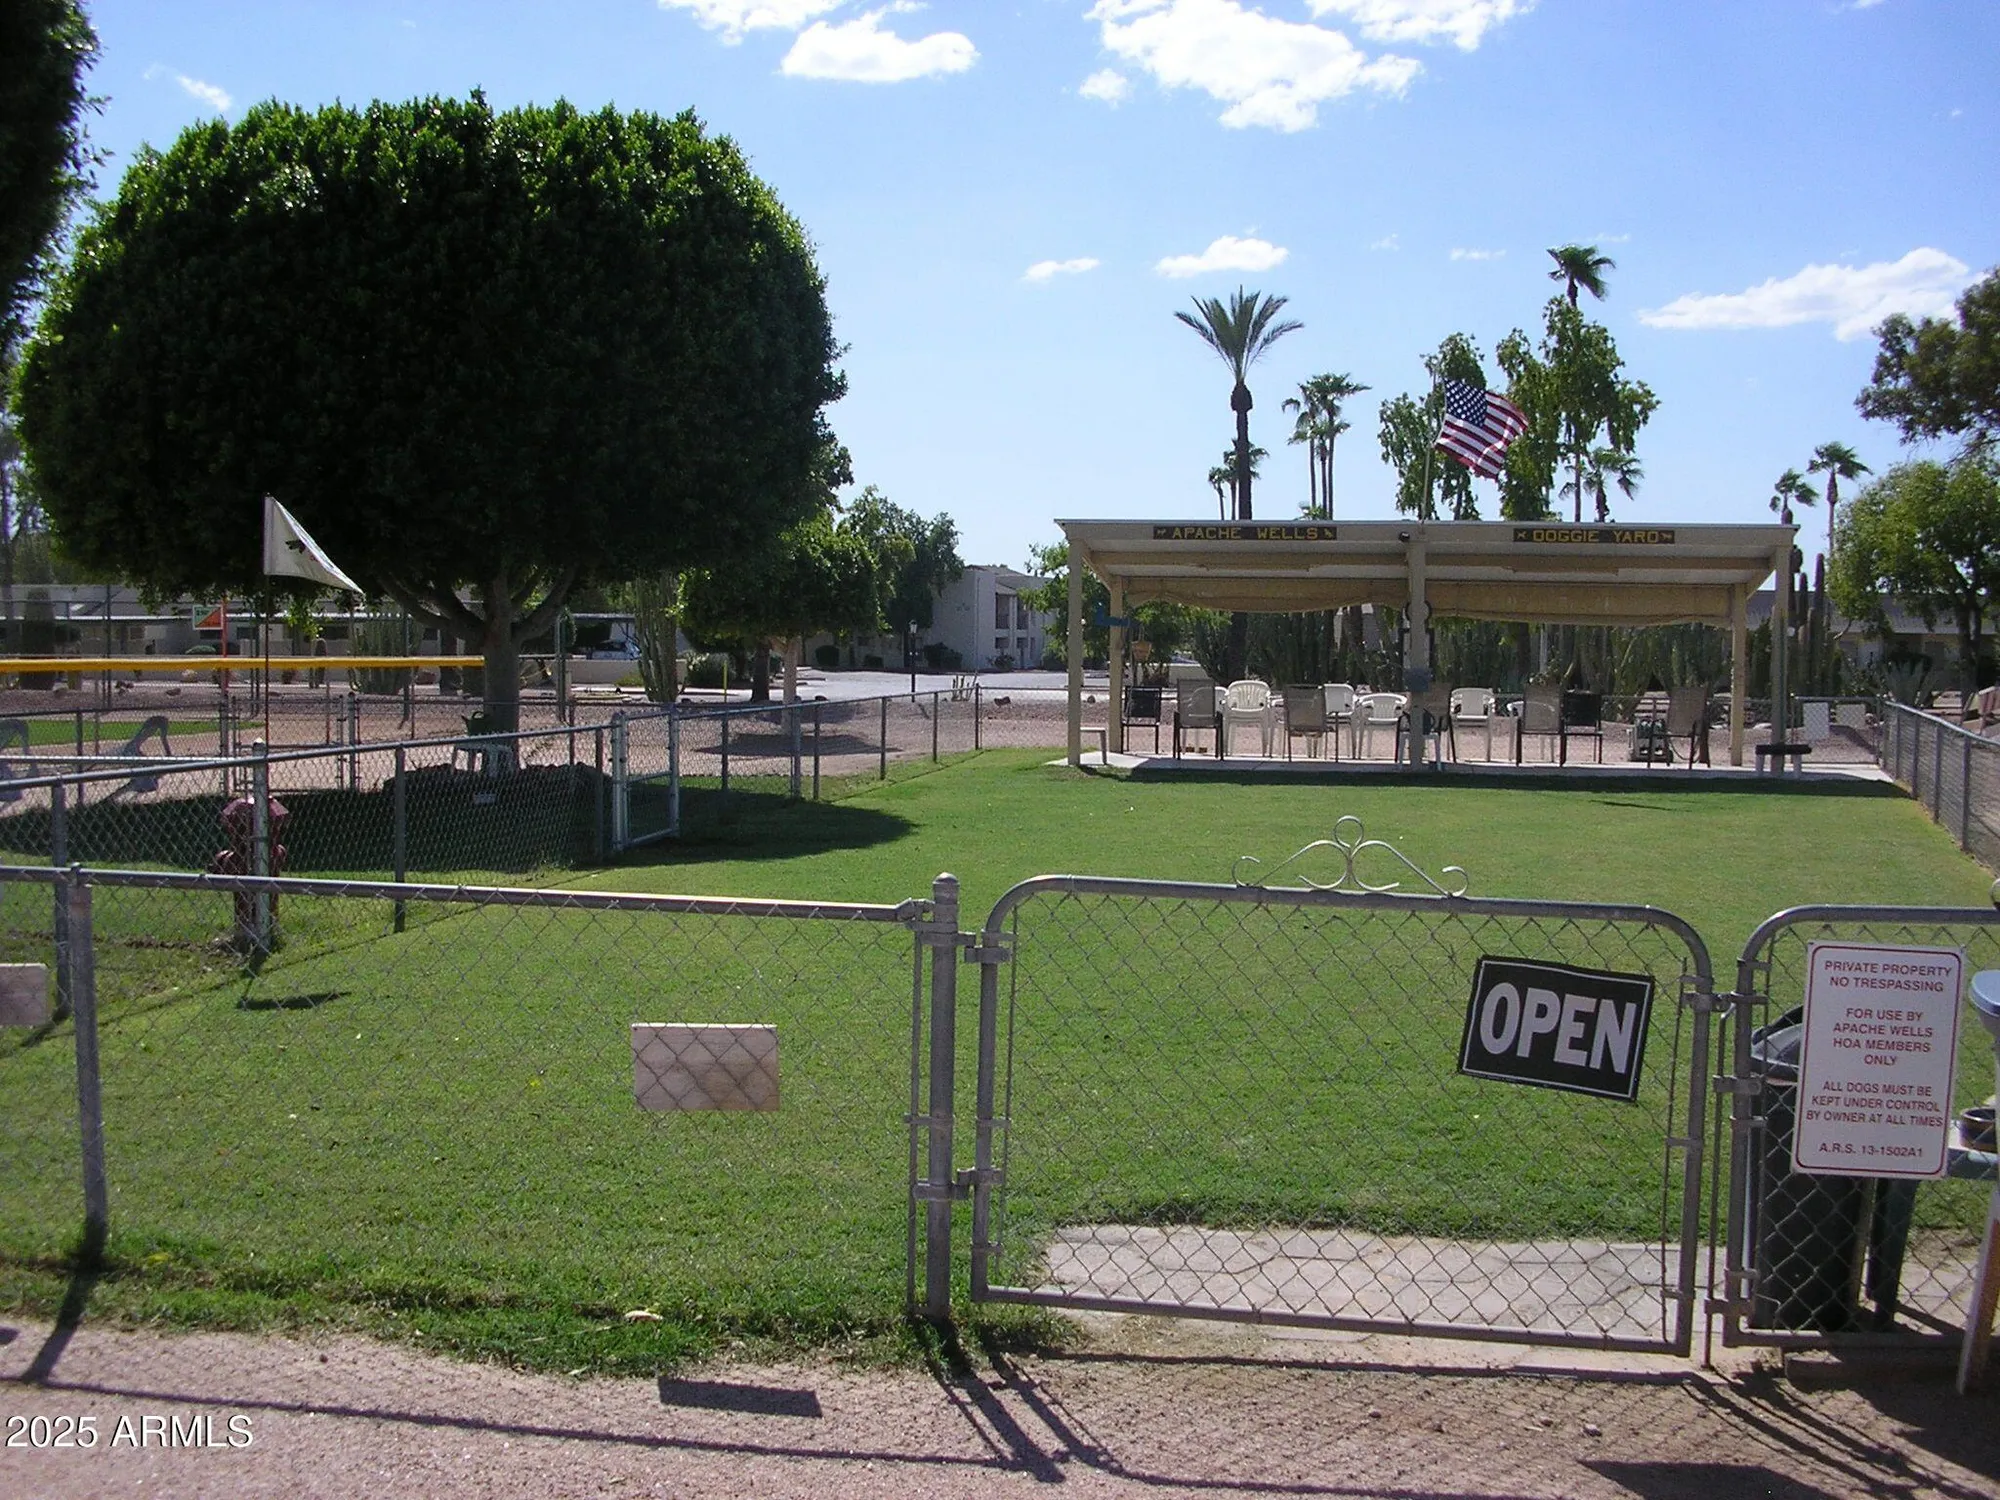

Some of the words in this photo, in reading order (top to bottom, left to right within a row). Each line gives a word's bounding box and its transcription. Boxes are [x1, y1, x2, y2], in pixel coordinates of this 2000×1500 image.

[1172, 527, 1241, 540] APACHE
[1256, 527, 1318, 540] WELLS
[1533, 529, 1599, 543] DOGGIE
[1613, 530, 1659, 544] YARD
[1825, 960, 1878, 974] PRIVATE
[1882, 964, 1952, 978] PROPERTY
[1830, 976, 1849, 987] NO
[1854, 977, 1944, 993] TRESPASSING
[1847, 1008, 1873, 1019] FOR
[1878, 1010, 1902, 1021] USE
[1907, 1011, 1923, 1021] BY
[1479, 982, 1637, 1075] OPEN
[1833, 1023, 1886, 1035] APACHE
[1890, 1026, 1933, 1038] WELLS
[1833, 1038, 1861, 1049] HOA
[1865, 1039, 1931, 1052] MEMBERS
[1864, 1054, 1897, 1066] ONLY
[1823, 1081, 1843, 1092] ALL
[1847, 1082, 1879, 1094] DOGS
[1882, 1084, 1913, 1095] MUST
[1917, 1086, 1932, 1097] BE
[1812, 1096, 1841, 1106] KEPT
[1844, 1097, 1883, 1109] UNDER
[1886, 1099, 1941, 1112] CONTROL
[1807, 1110, 1821, 1121] BY
[1824, 1111, 1866, 1123] OWNER
[1869, 1114, 1882, 1123] AT
[1886, 1114, 1906, 1125] ALL
[1910, 1115, 1943, 1127] TIMES
[1819, 1142, 1856, 1154] A.R.S.
[1862, 1145, 1923, 1157] 13-1502A1
